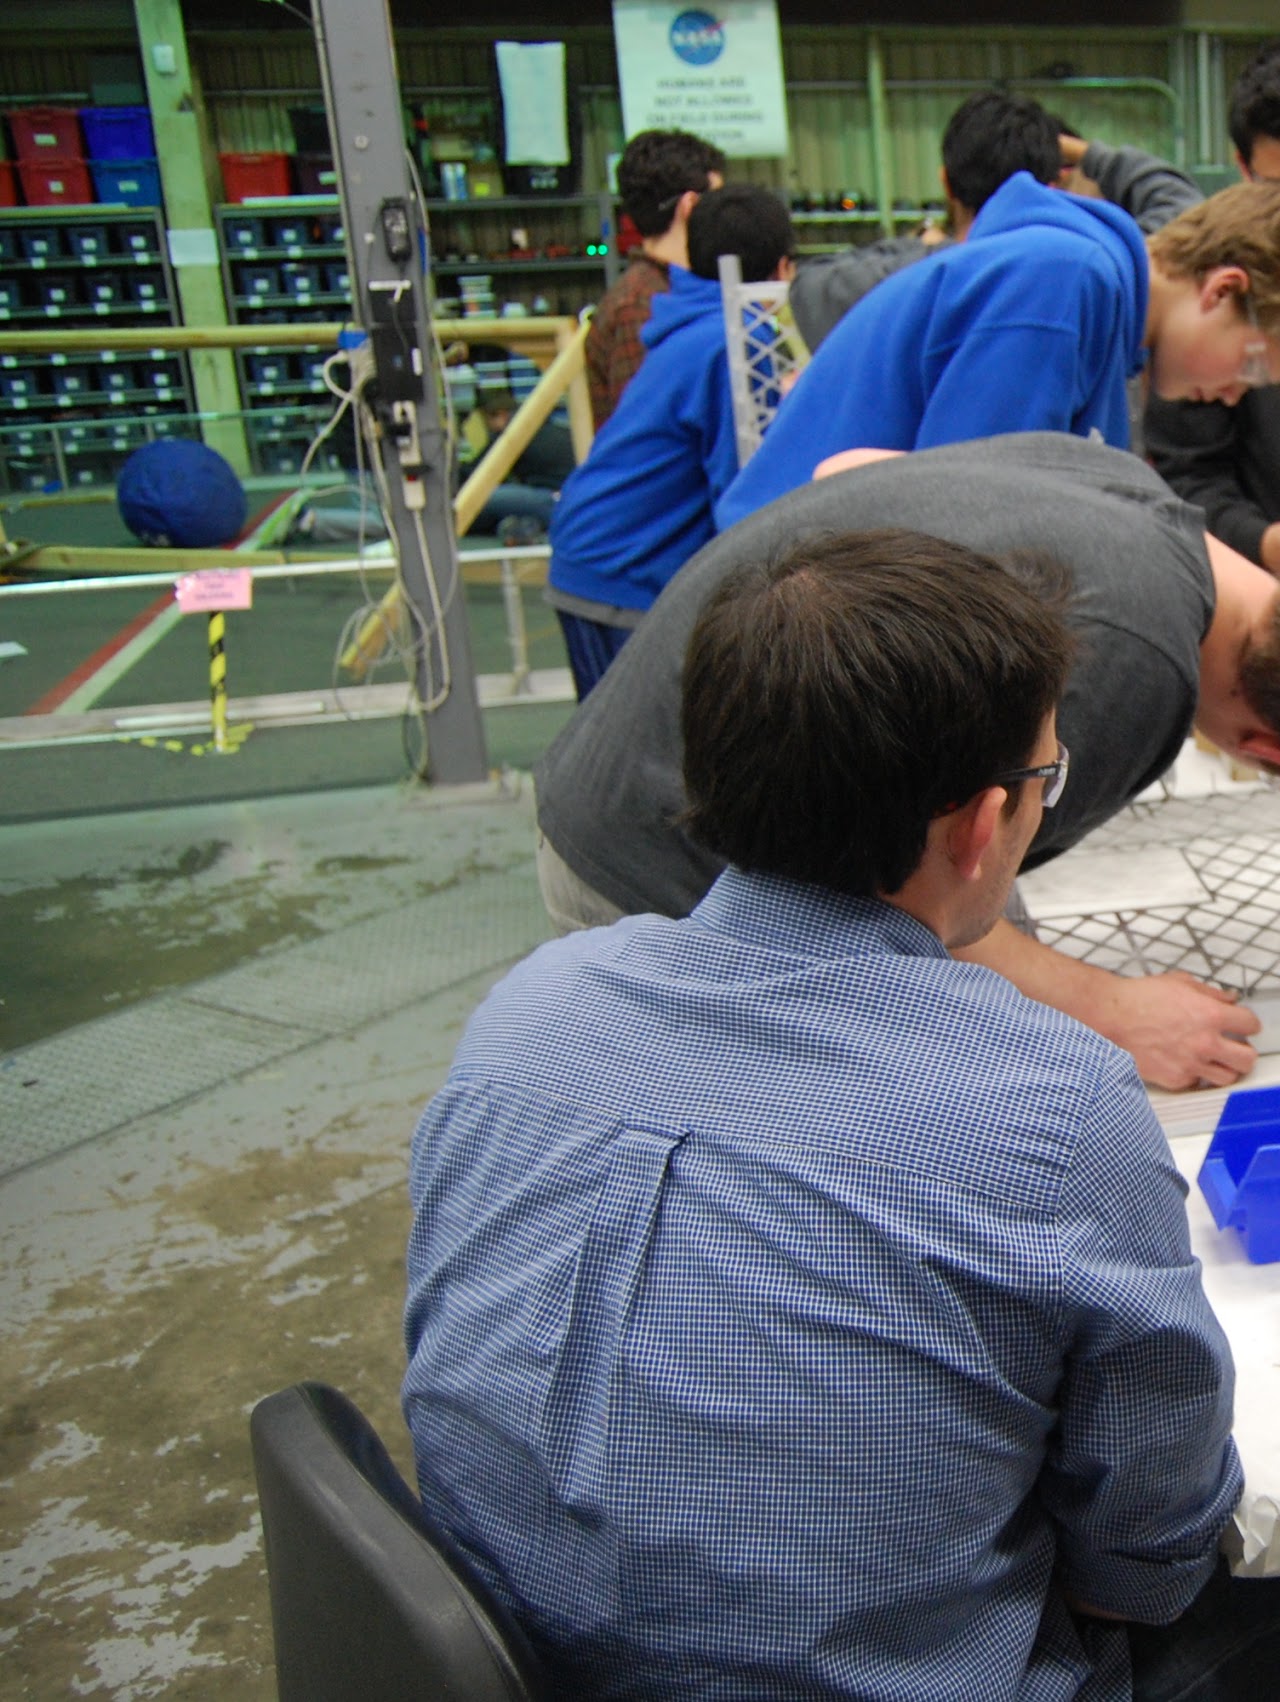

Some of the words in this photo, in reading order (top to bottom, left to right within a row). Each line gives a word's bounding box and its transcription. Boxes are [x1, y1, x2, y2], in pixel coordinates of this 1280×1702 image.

[720, 77, 745, 87] ARE
[655, 96, 681, 106] NOT
[688, 95, 752, 105] ALLOWED
